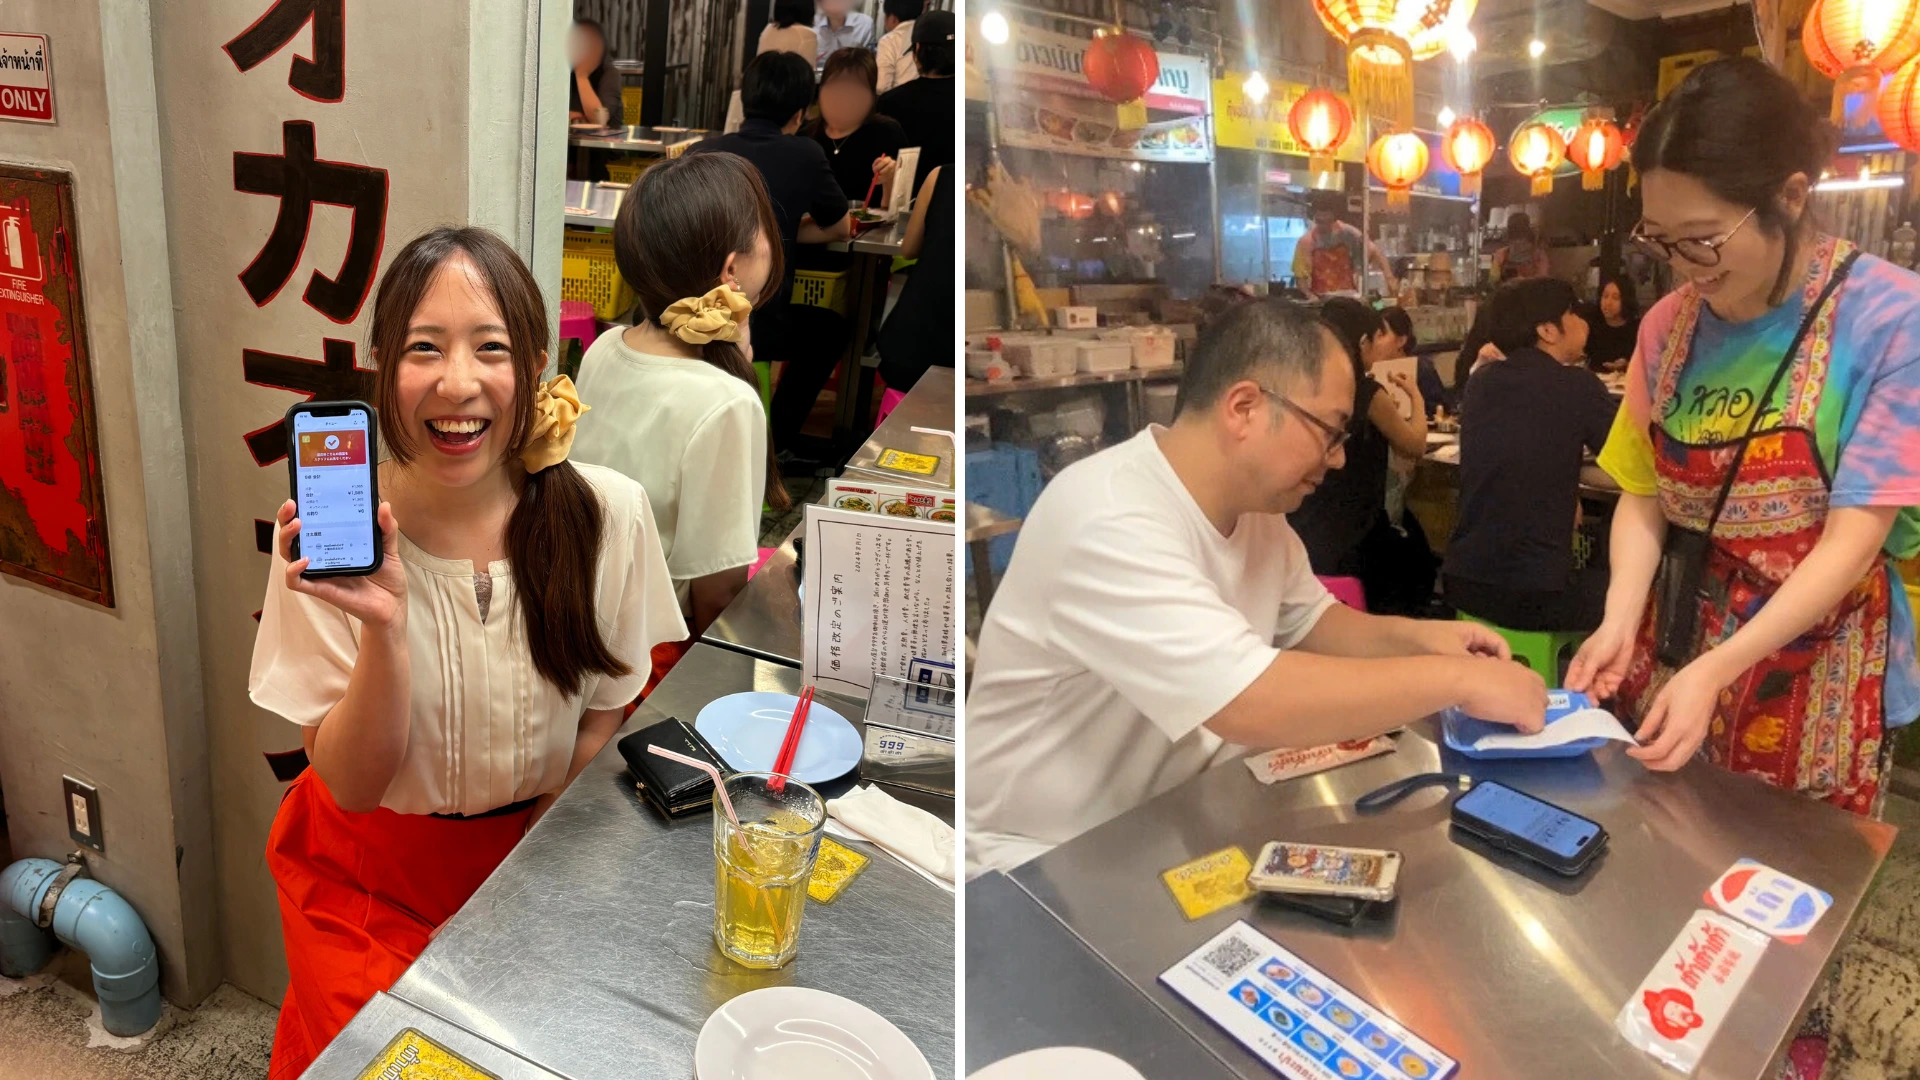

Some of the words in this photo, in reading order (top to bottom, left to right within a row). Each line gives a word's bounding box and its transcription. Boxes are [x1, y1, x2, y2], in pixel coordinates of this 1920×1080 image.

[1, 88, 47, 112] ONLY
[11, 278, 28, 291] FIRE
[0, 287, 45, 305] EXTINGUISHER
[829, 574, 843, 672] 価格改定のご案内
